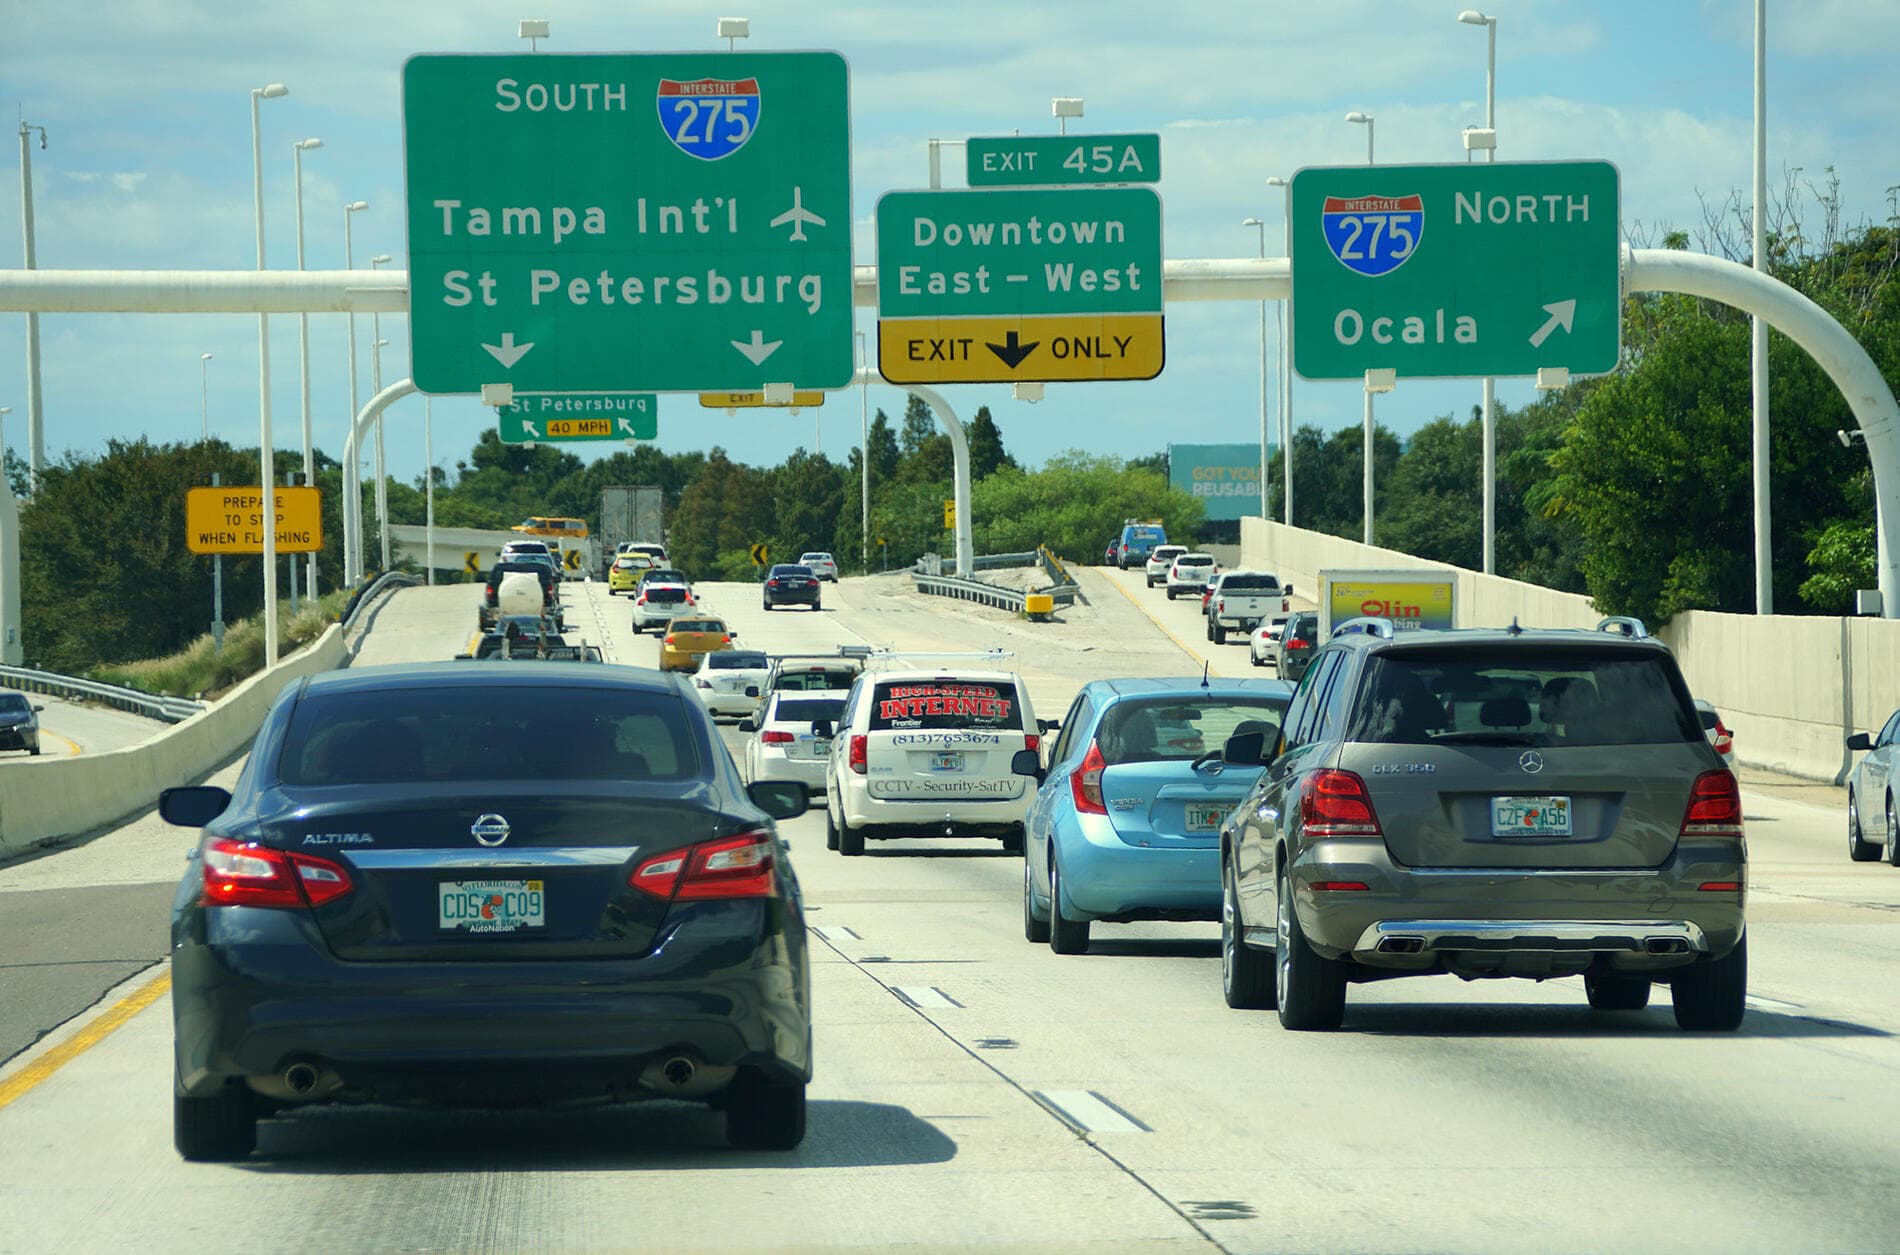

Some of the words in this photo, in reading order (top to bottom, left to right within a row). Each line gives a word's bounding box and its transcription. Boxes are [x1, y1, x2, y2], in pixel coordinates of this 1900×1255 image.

[495, 79, 626, 112] SOUTH
[680, 83, 736, 94] INTERSTATE
[674, 99, 750, 143] 275
[983, 152, 1038, 172] EXIT
[1062, 146, 1143, 173] 45A
[1345, 199, 1400, 211] INTERSTATE
[1455, 191, 1589, 224] NORTH
[433, 199, 606, 245] Tampa
[638, 197, 738, 234] Int'l
[914, 216, 1125, 246] Downtown
[1338, 215, 1413, 260] 275
[900, 264, 990, 294] East
[1044, 262, 1141, 292] West
[442, 270, 497, 306] St
[531, 268, 822, 314] Petersburg
[1334, 308, 1478, 345] Ocala
[908, 338, 974, 361] EXIT
[1052, 336, 1132, 359] ONLY
[510, 398, 530, 412] St
[541, 397, 646, 412] Petersburg
[730, 394, 754, 402] EXIT
[550, 422, 570, 434] 40
[578, 420, 608, 432] MPH
[1192, 466, 1225, 480] GOT
[1228, 466, 1262, 480] YOU
[1192, 482, 1262, 496] REUSABL
[224, 496, 284, 508] PREPAE
[225, 514, 241, 526] TO
[250, 514, 284, 526] STP
[200, 532, 236, 544] WHEN
[1360, 600, 1421, 618] Olin
[890, 685, 996, 698] HIGH-SPEED
[880, 697, 1012, 720] INTERNET
[892, 719, 922, 727] Frontier
[874, 780, 913, 793] CCTV
[1497, 808, 1522, 825] CZF
[1541, 808, 1566, 825] A56
[473, 825, 510, 834] NISSAN
[302, 833, 374, 844] ALTIMA
[444, 894, 480, 918] CDS
[505, 892, 540, 916] C09
[470, 925, 515, 933] AutoNation
